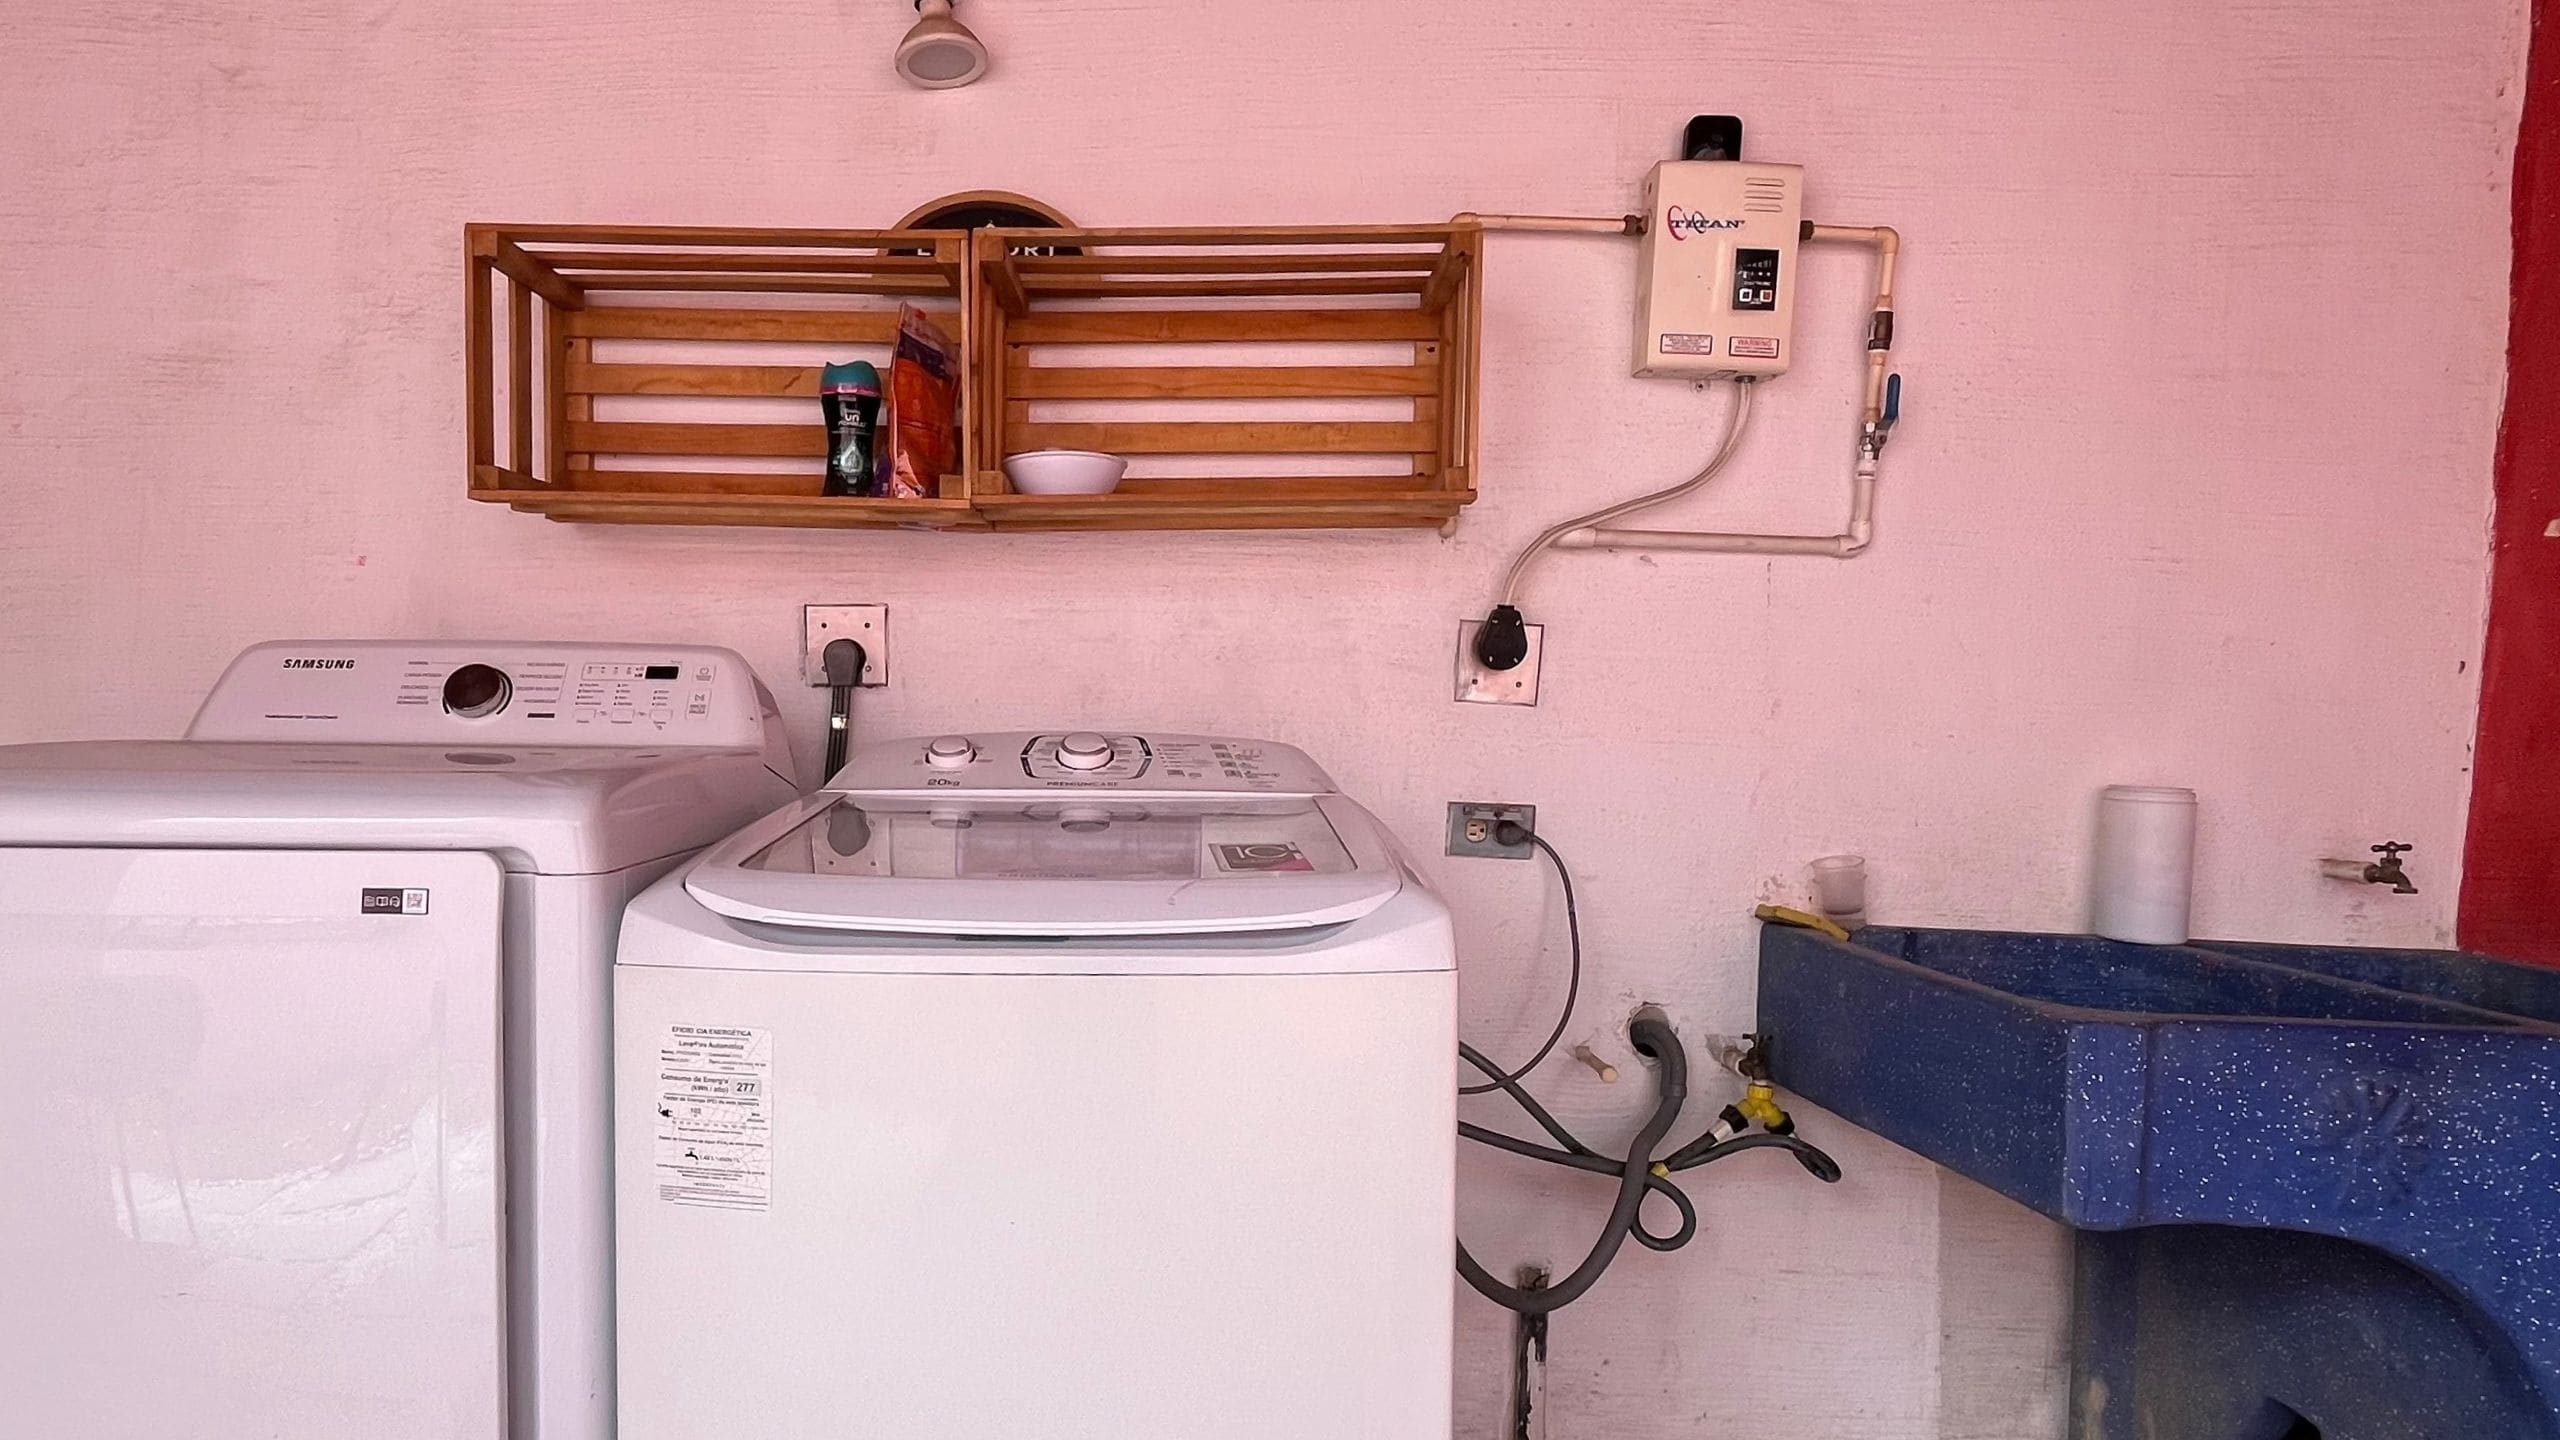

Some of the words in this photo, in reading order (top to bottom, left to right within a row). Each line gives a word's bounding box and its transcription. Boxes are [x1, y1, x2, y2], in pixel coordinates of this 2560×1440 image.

[283, 658, 355, 669] SAMSUNG
[660, 1073, 692, 1082] Consumo
[693, 1075, 702, 1083] de
[736, 1082, 756, 1093] 277
